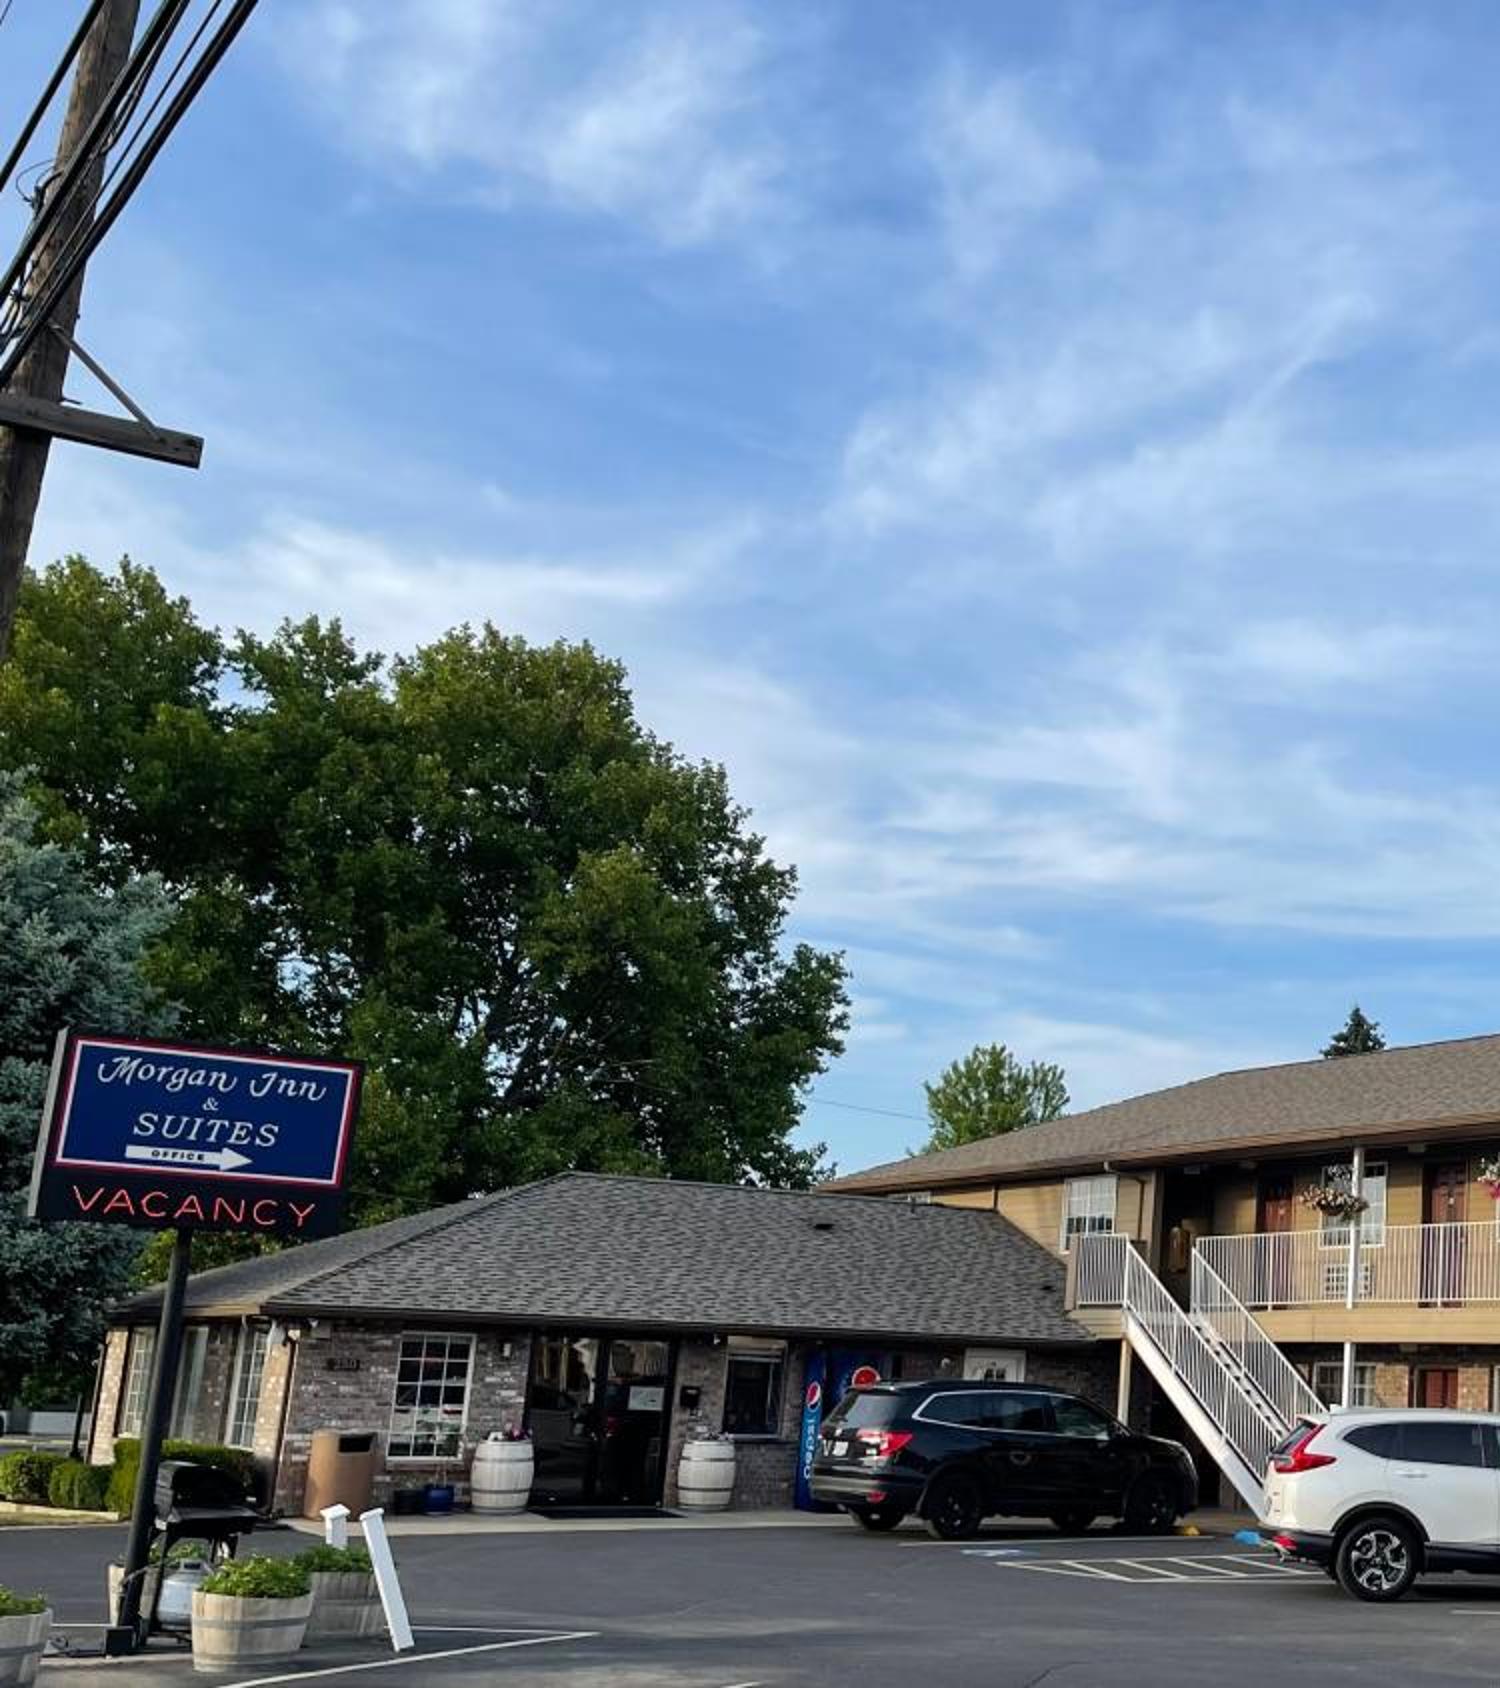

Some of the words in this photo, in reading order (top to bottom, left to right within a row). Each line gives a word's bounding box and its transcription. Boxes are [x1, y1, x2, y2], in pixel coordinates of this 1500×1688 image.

[98, 1056, 237, 1092] Morgan
[250, 1072, 327, 1101] Inn
[202, 1097, 219, 1112] &
[133, 1113, 279, 1147] SUITES
[151, 1149, 205, 1161] OFFICE
[73, 1185, 316, 1227] VACANCY
